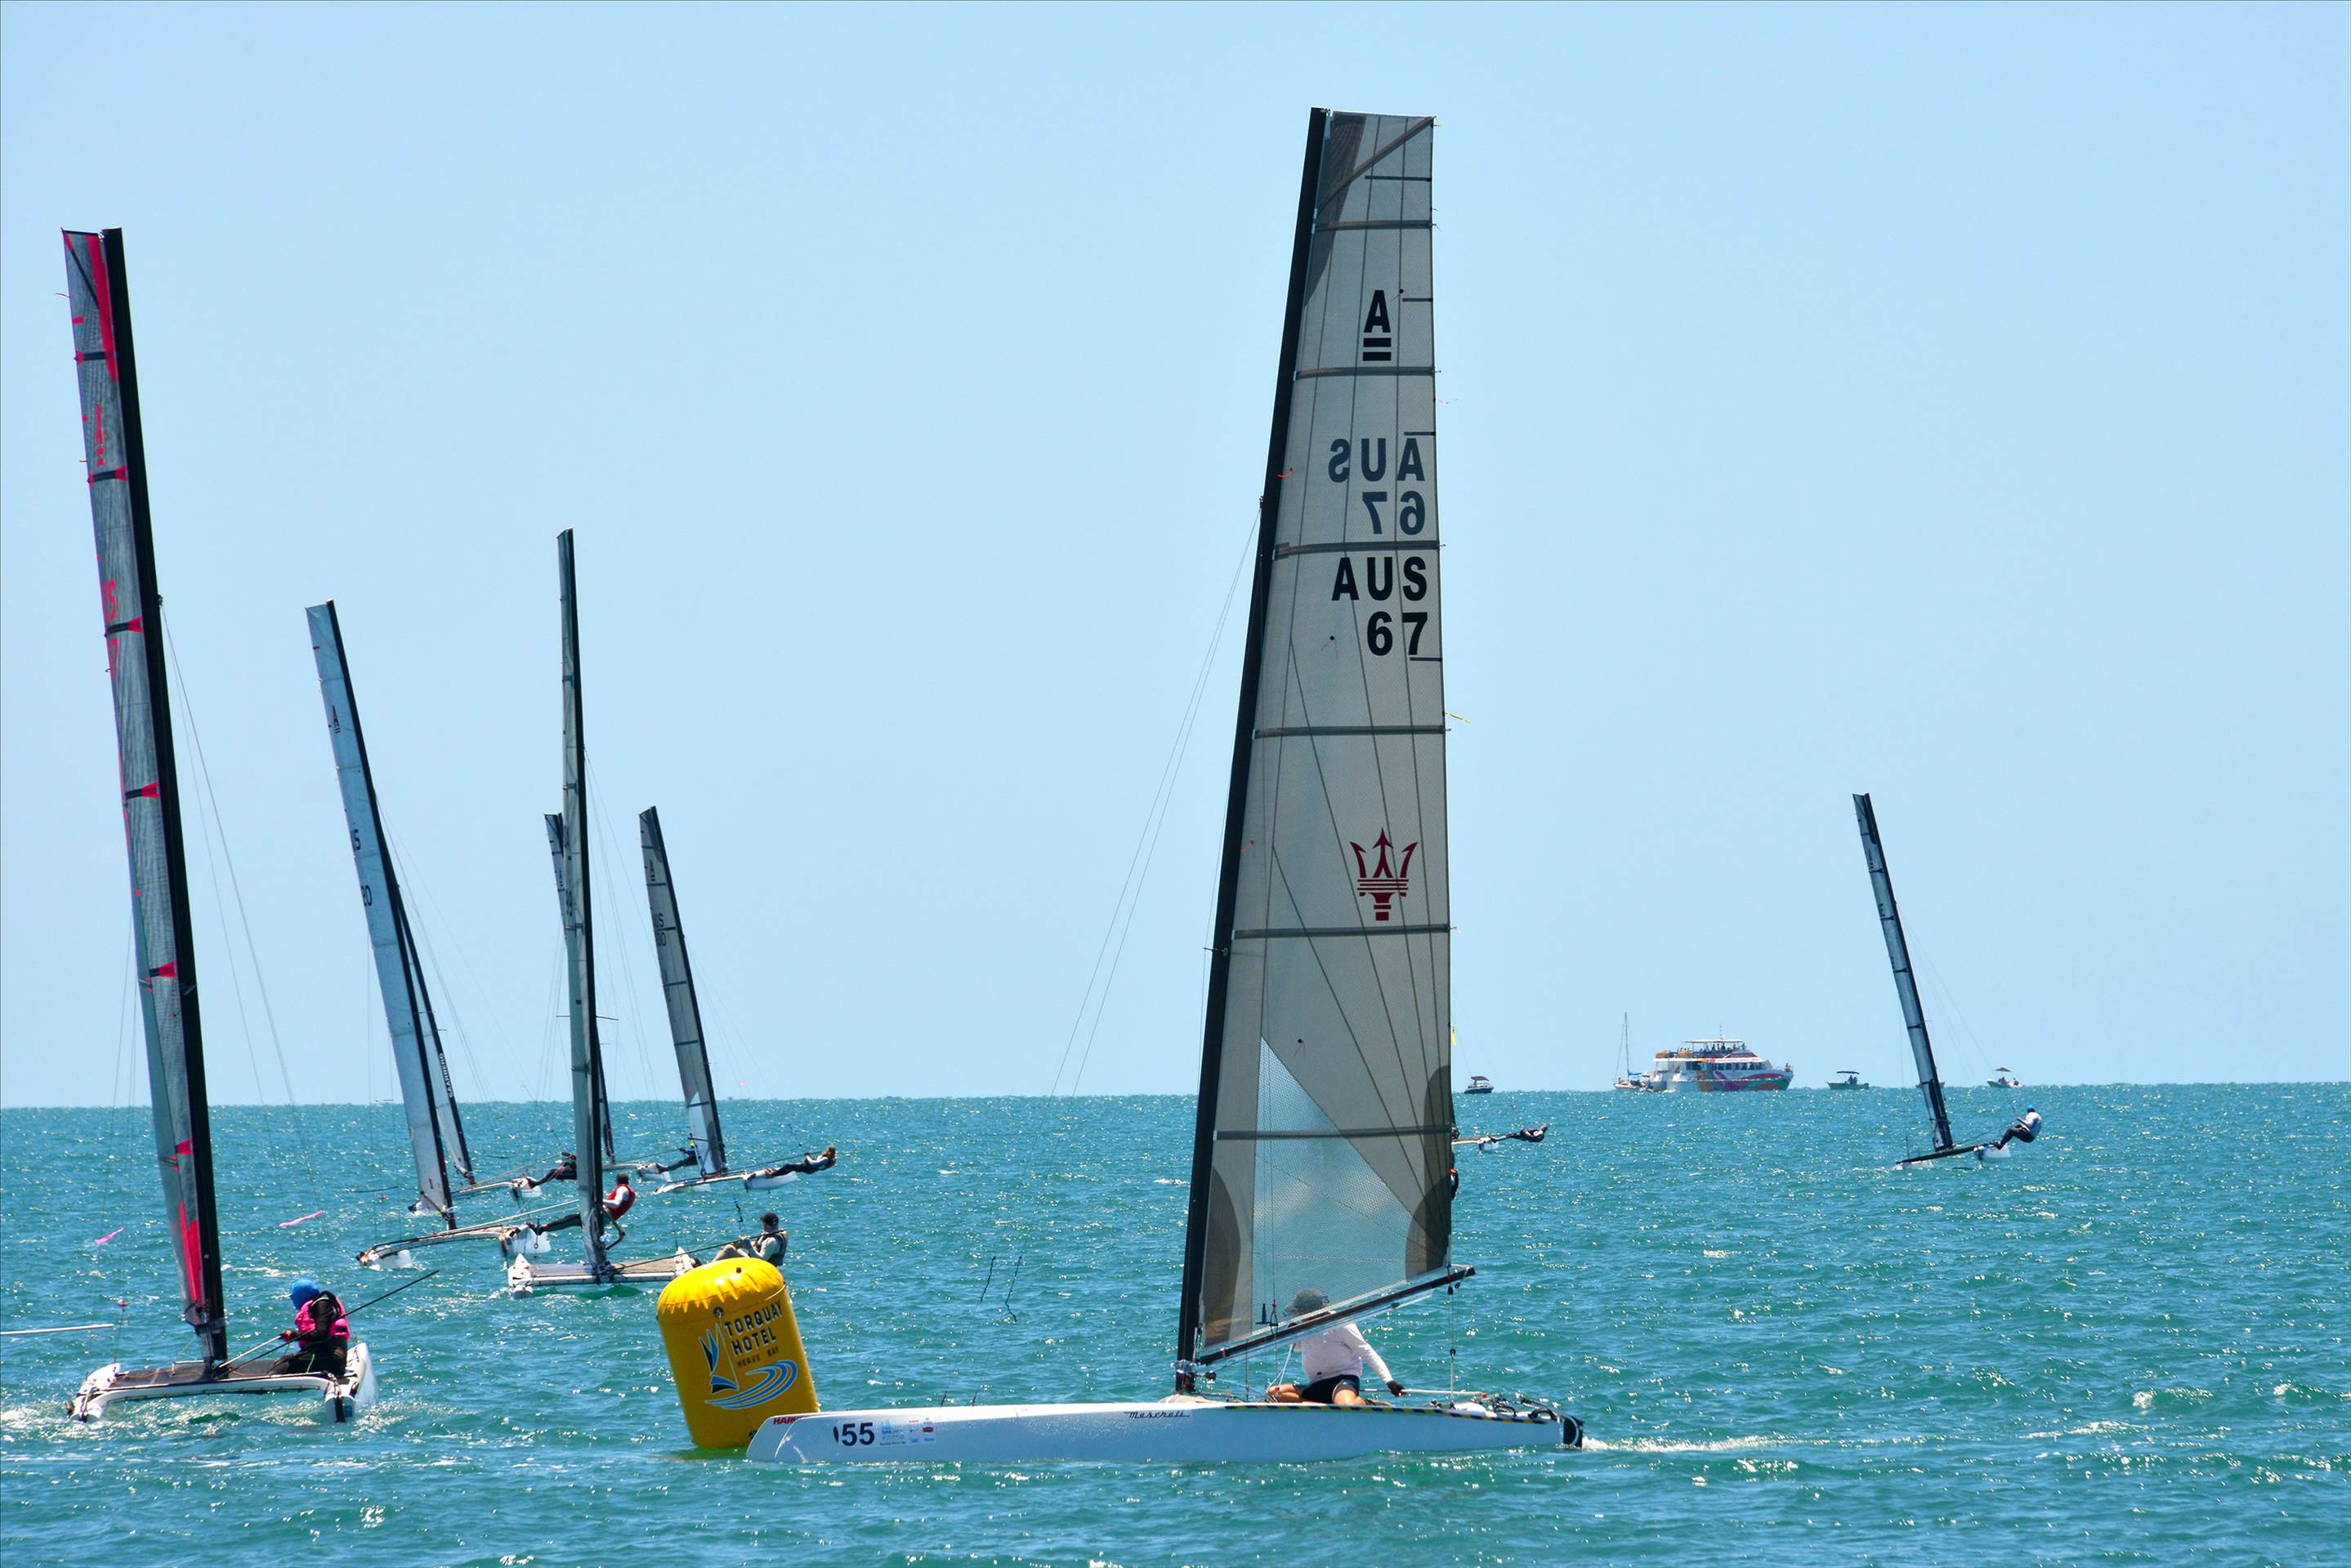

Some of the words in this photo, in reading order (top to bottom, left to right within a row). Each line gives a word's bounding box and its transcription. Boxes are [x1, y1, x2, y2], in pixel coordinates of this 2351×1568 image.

[1331, 556, 1427, 601] AUS
[1366, 611, 1428, 656] 67
[724, 1300, 782, 1338] TORQUAY
[731, 1326, 776, 1356] HOTEL
